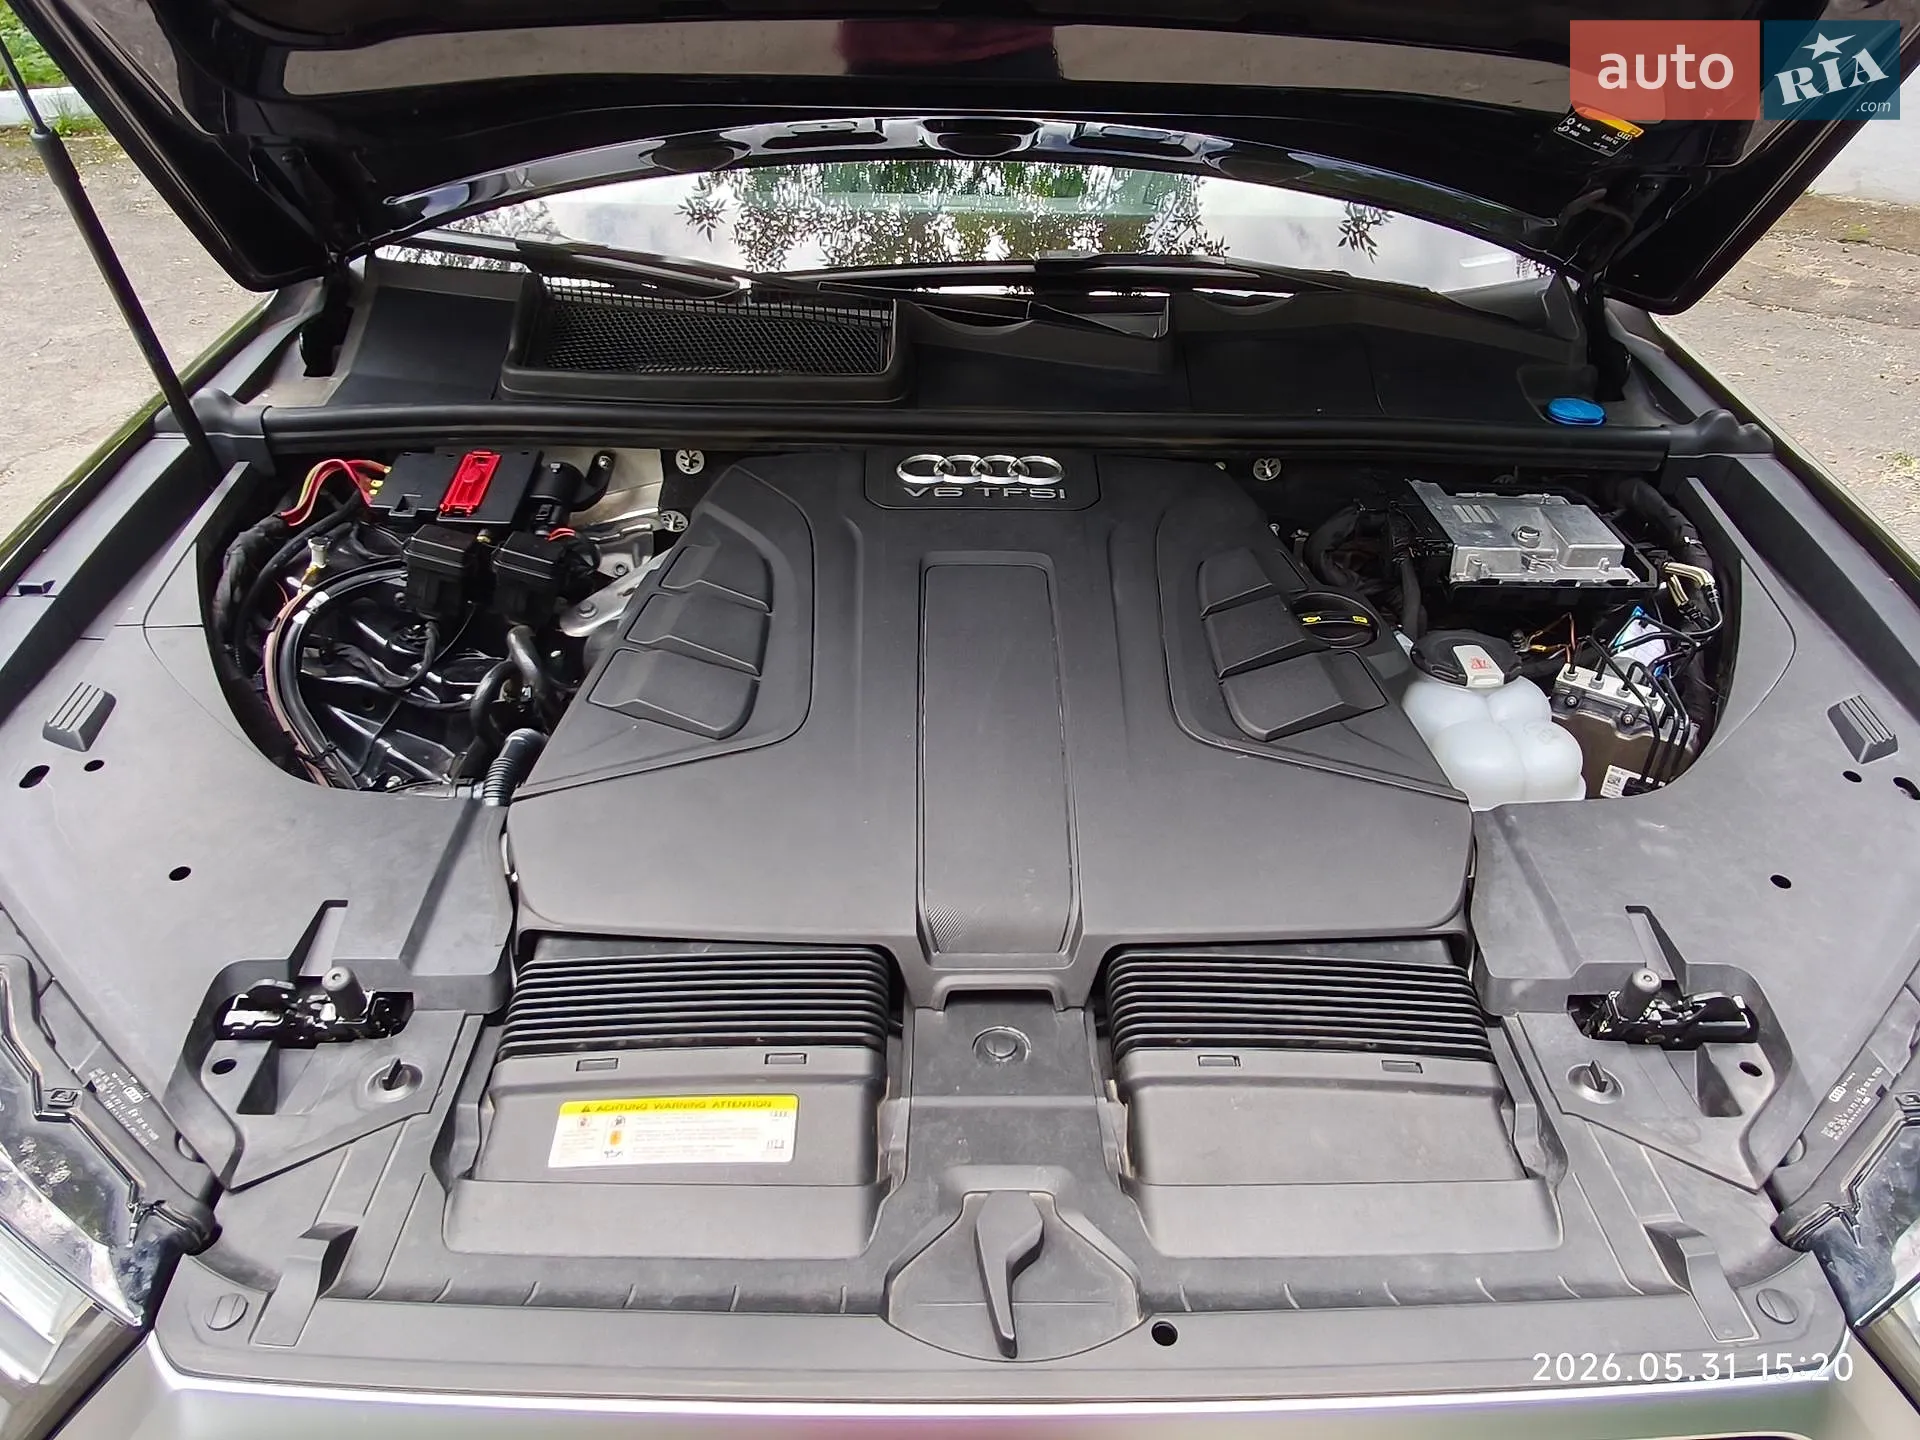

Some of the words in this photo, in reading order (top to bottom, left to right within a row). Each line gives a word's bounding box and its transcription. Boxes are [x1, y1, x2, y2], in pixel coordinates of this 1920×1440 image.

[904, 486, 964, 498] V6
[975, 486, 1066, 499] TFSI
[594, 1103, 649, 1113] ACHTUNG
[654, 1101, 706, 1110] WARNING
[711, 1099, 773, 1109] ATTENTION
